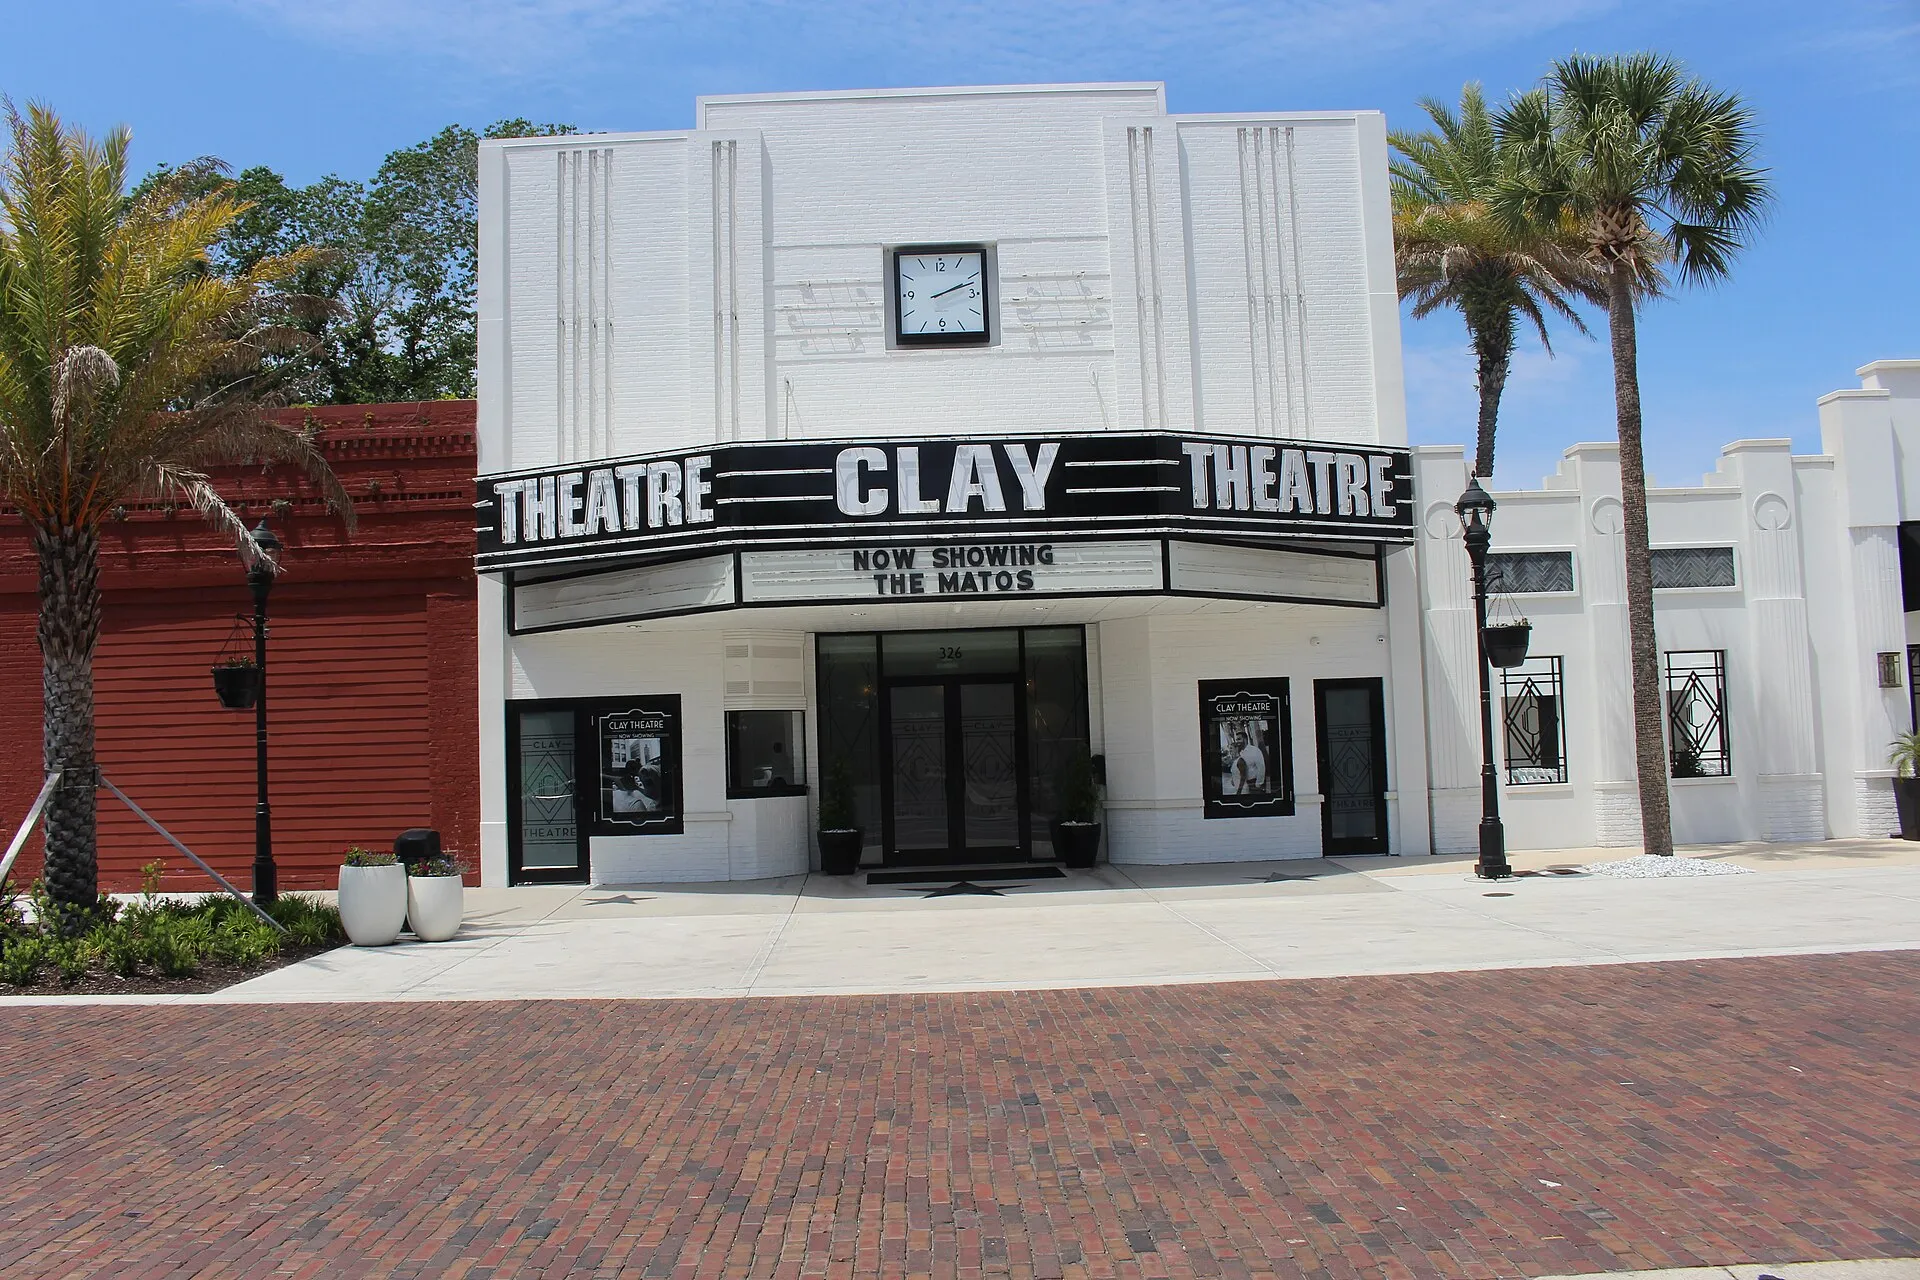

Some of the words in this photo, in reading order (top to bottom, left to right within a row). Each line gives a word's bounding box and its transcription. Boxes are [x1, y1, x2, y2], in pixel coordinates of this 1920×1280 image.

[935, 262, 945, 272] 12
[907, 290, 915, 300] 9
[968, 288, 976, 299] 3
[938, 318, 946, 328] 6
[835, 443, 1061, 516] CLAY
[1182, 442, 1397, 518] THEATRE
[493, 455, 715, 545] THEATRE
[853, 548, 916, 571] NOW
[932, 544, 1054, 568] SHOWING
[873, 572, 924, 595] THE
[938, 570, 1034, 593] MATOS
[939, 646, 962, 659] 326
[1215, 703, 1235, 713] CLAY
[1237, 702, 1271, 712] THEATRE
[608, 721, 628, 730] CLAY
[630, 719, 664, 729] THEATRE
[1337, 729, 1360, 737] CLAY
[533, 741, 561, 749] CLAY
[523, 827, 576, 838] THEATRE
